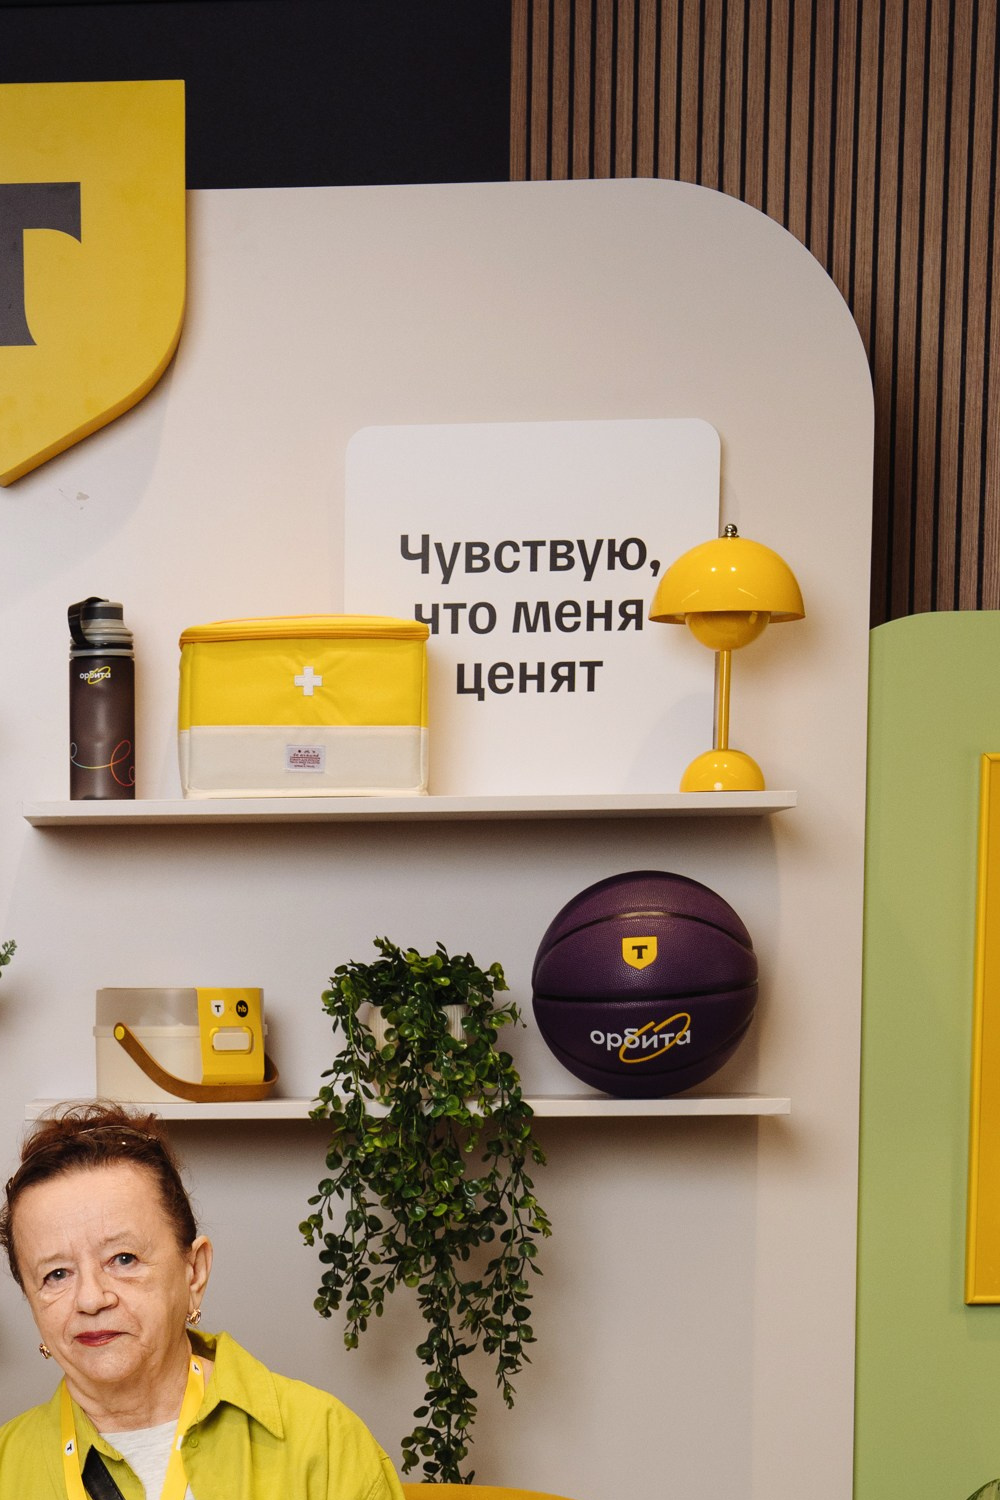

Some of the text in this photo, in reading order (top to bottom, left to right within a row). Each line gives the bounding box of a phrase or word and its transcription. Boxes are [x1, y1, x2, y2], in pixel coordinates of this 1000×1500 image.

[400, 535, 661, 585] Чувствую,
[414, 599, 644, 635] что меня
[456, 661, 604, 702] ценят
